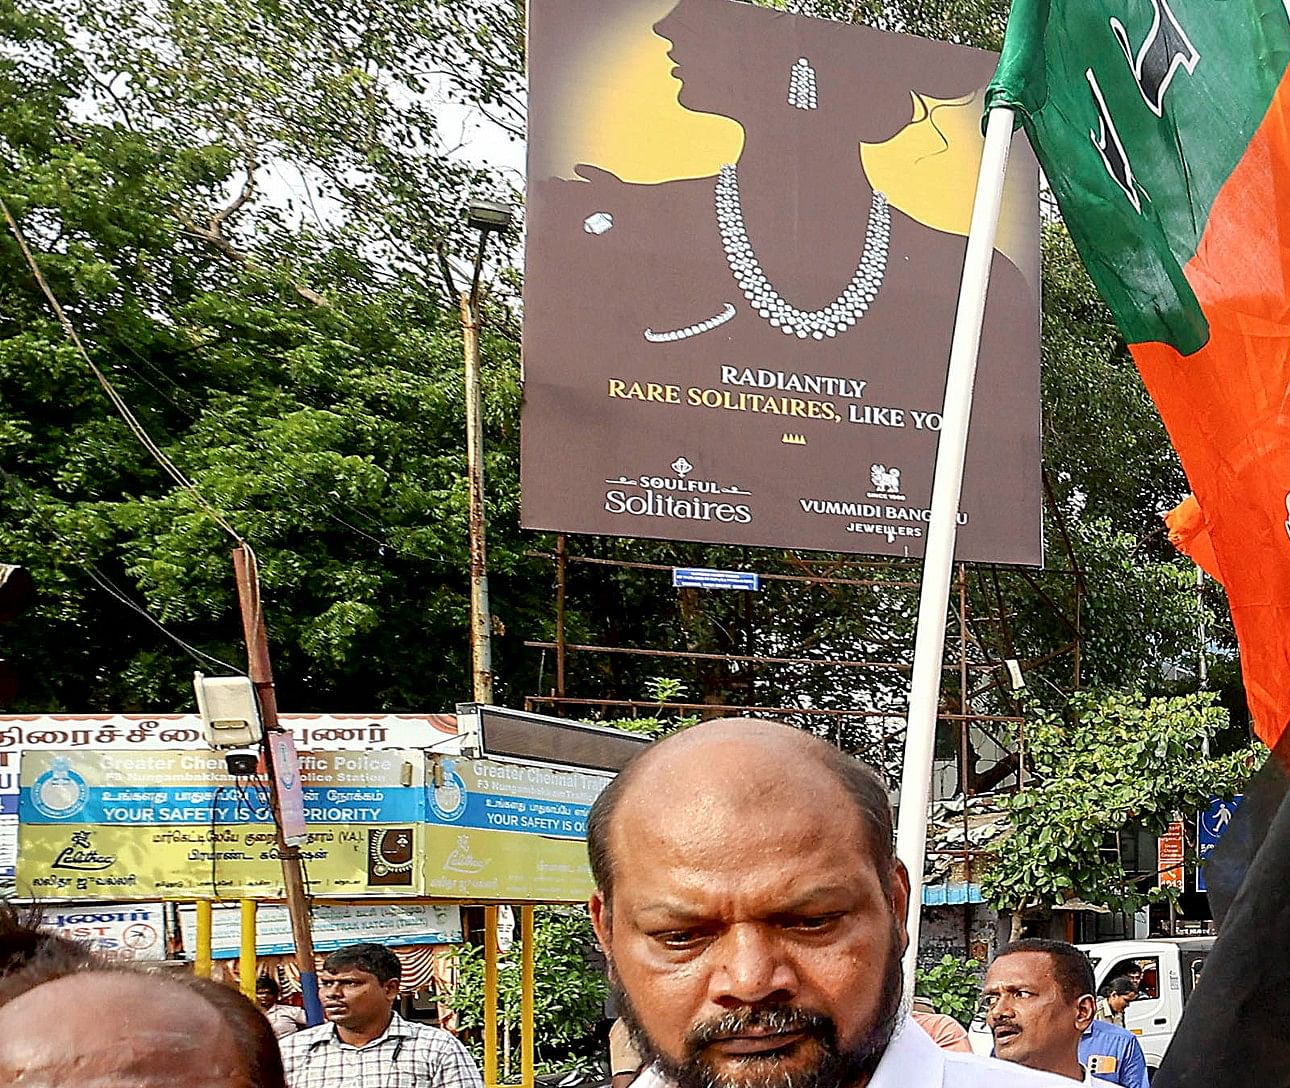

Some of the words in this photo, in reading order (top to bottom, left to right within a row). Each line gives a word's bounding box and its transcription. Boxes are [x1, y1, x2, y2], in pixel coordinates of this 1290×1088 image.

[721, 365, 867, 398] RADIANTLY
[608, 378, 681, 404] RARE
[687, 387, 842, 423] SOLITAIRES,
[848, 404, 904, 428] LIKE
[911, 410, 945, 432] YO
[640, 475, 719, 495] SOULFUL
[866, 492, 887, 500] SINCE
[605, 490, 752, 524] Solitaires
[800, 500, 881, 518] VUMMIDI
[885, 506, 969, 526] BANGU
[846, 523, 922, 537] JEWELLERS
[287, 723, 389, 745] புணர்
[103, 756, 176, 769] Greater
[181, 756, 226, 770] Chen
[334, 757, 392, 770] Police
[300, 773, 332, 782] olice
[337, 772, 387, 783] Station
[474, 761, 523, 781] Greater
[528, 768, 577, 789] Chennai
[326, 789, 384, 804] நோக்கம்
[103, 808, 154, 821] YOUR
[160, 808, 229, 821] SAFETY
[234, 808, 250, 821] IS
[302, 808, 381, 821] PRIORITY
[487, 813, 518, 826] YOUR
[521, 816, 560, 830] SAFETY
[562, 821, 572, 831] IS
[574, 822, 588, 832] OU
